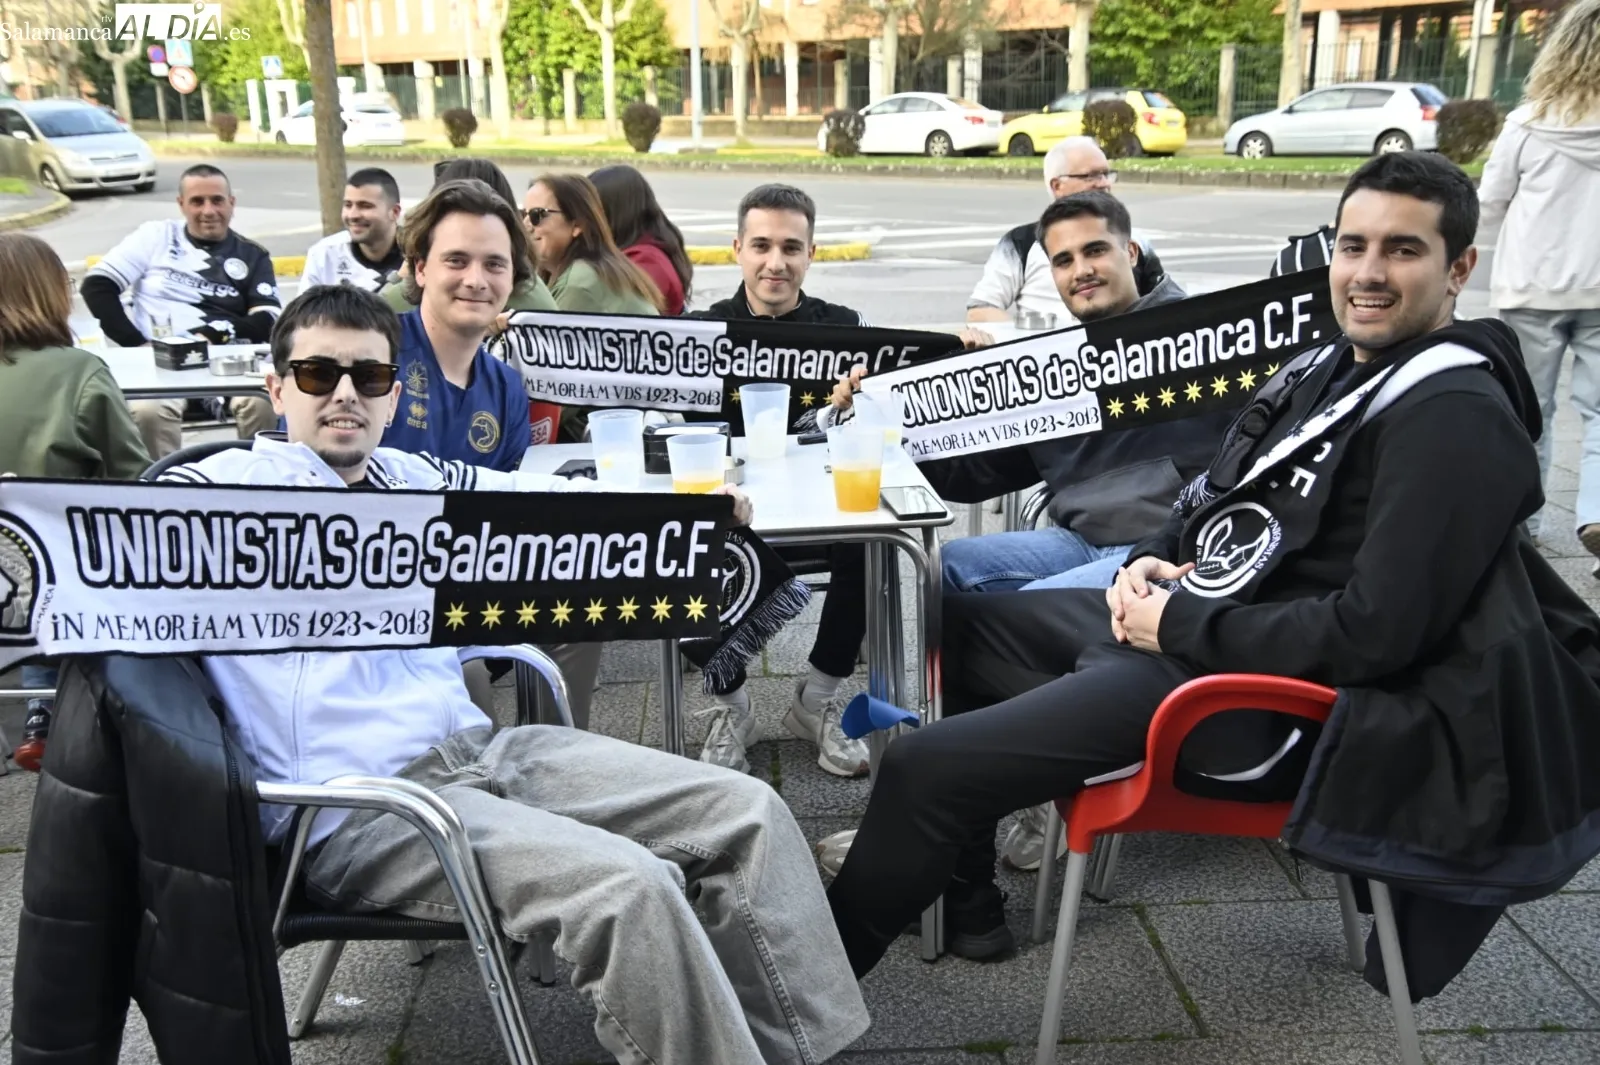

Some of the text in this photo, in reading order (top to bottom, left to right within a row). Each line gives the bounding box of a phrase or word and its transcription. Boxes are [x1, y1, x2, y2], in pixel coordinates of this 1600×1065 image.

[514, 324, 673, 376] UNIONISTAS
[676, 337, 711, 377] de
[713, 333, 869, 382] Salamanca
[890, 293, 1320, 428] UNIONISTAS de Salamanca C.F.
[613, 385, 642, 401] VDS
[991, 422, 1021, 441] VDS
[67, 506, 720, 589] UNIONISTAS de Salamanca C.F.
[250, 611, 301, 639] VDS
